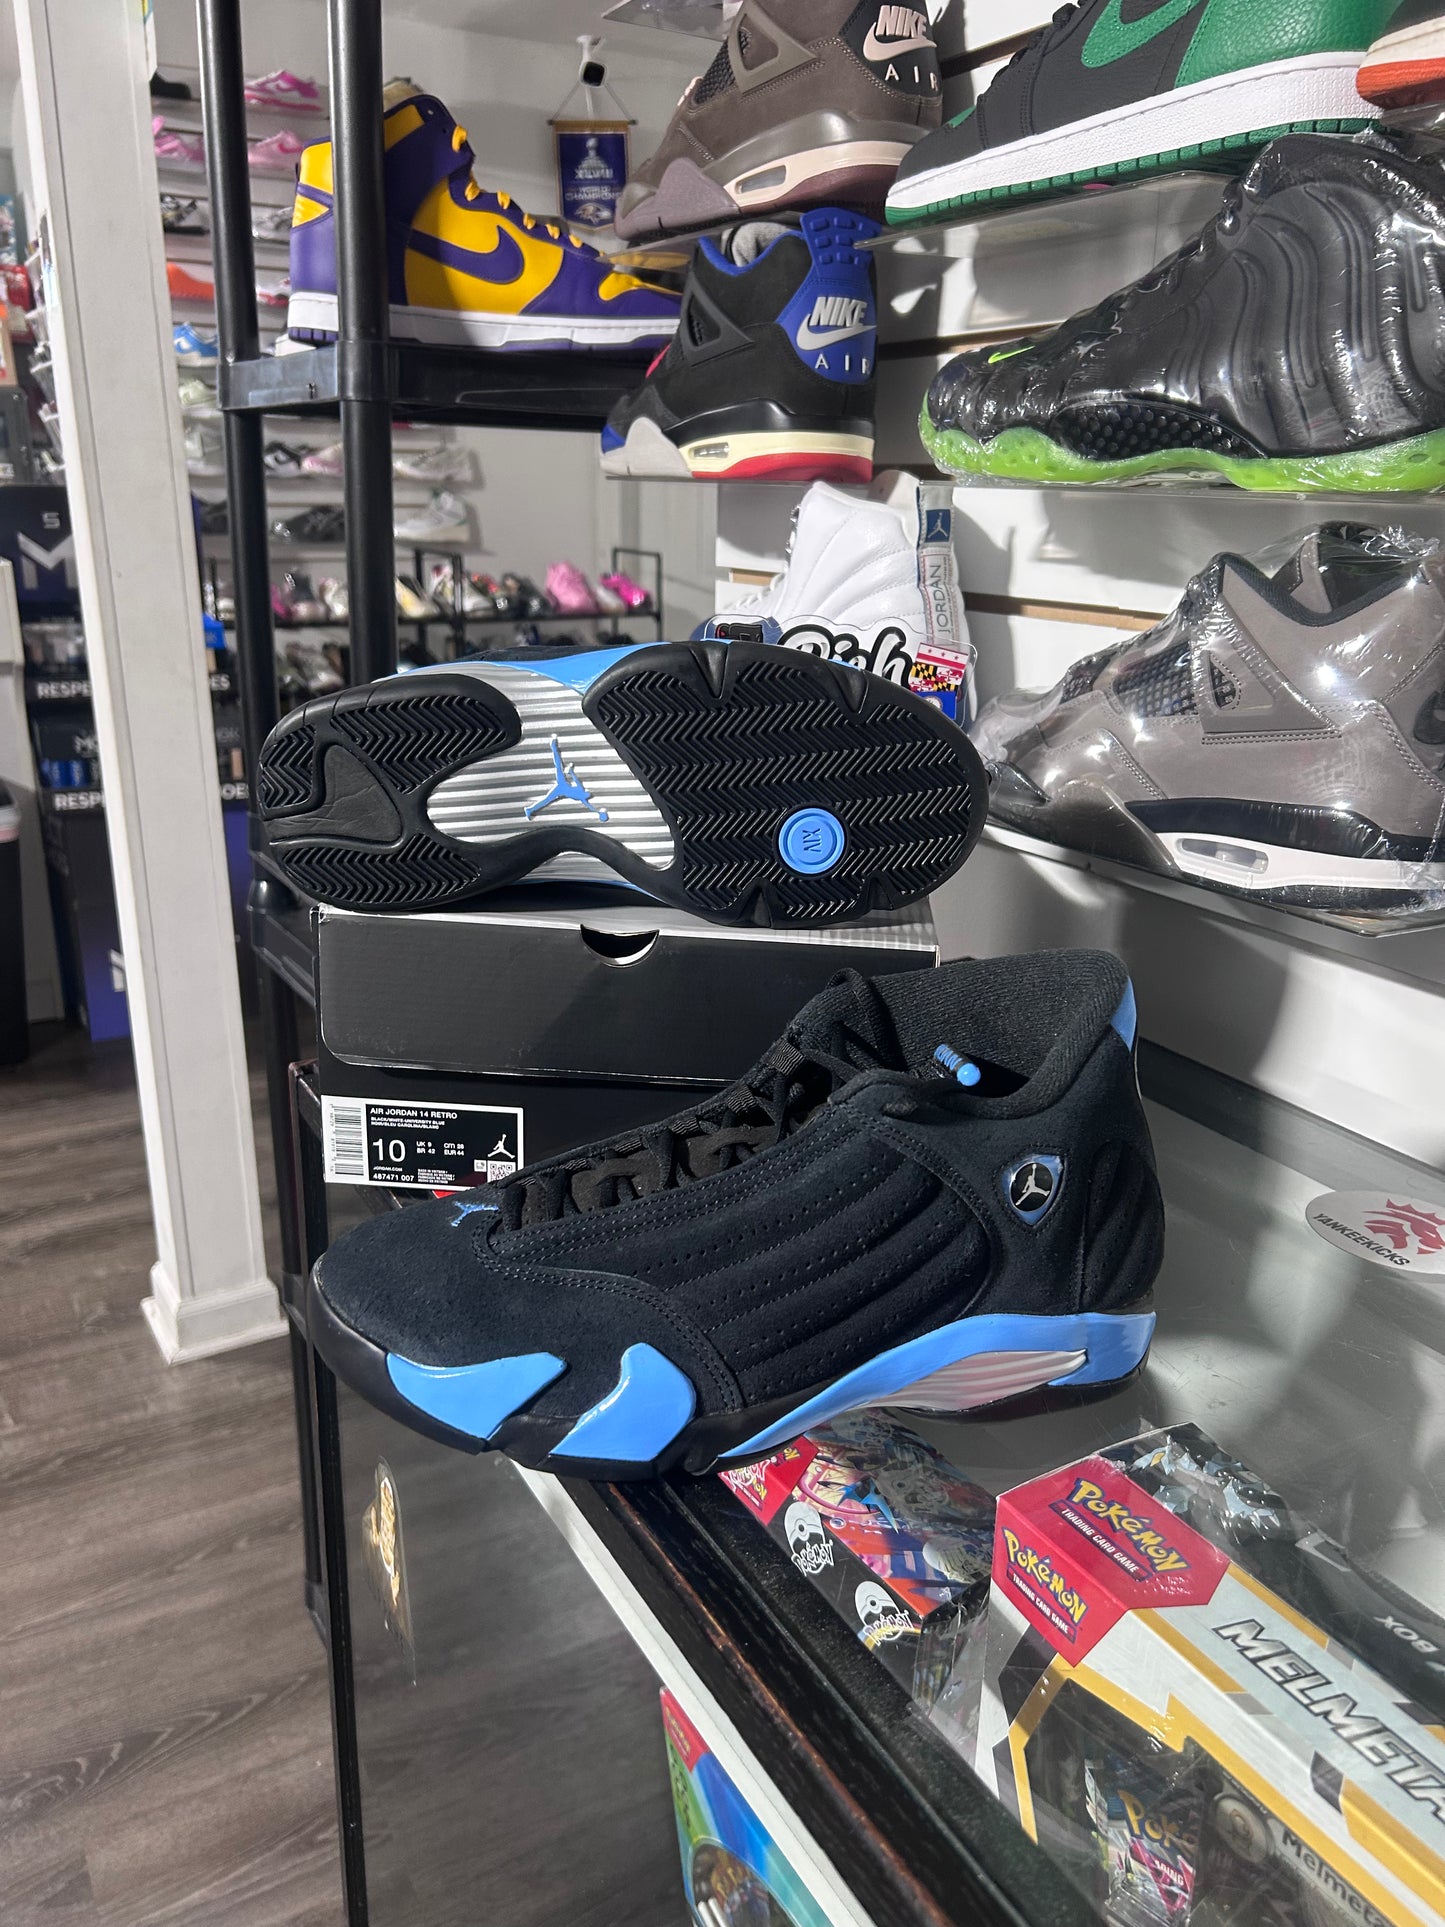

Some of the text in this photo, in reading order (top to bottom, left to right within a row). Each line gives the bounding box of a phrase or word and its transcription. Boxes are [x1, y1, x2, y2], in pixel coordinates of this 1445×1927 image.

[876, 4, 927, 39] NIKE
[884, 63, 939, 92] AIR
[808, 296, 868, 328] NIKE
[814, 353, 871, 375] AIR
[929, 564, 952, 633] JORDAN
[802, 827, 822, 853] XIV
[370, 1107, 458, 1120] AIR JORDAN 14 RETRO
[372, 1138, 406, 1162] 10
[416, 1140, 426, 1148] UK
[373, 1172, 399, 1181] 487471
[400, 1174, 415, 1182] 007
[1312, 1212, 1411, 1266] YANKEEKICKS
[1061, 1508, 1140, 1574] TRADING CARD GAME
[1012, 1573, 1070, 1635] TRADING CARD GAME
[1373, 1615, 1440, 1654] BOX
